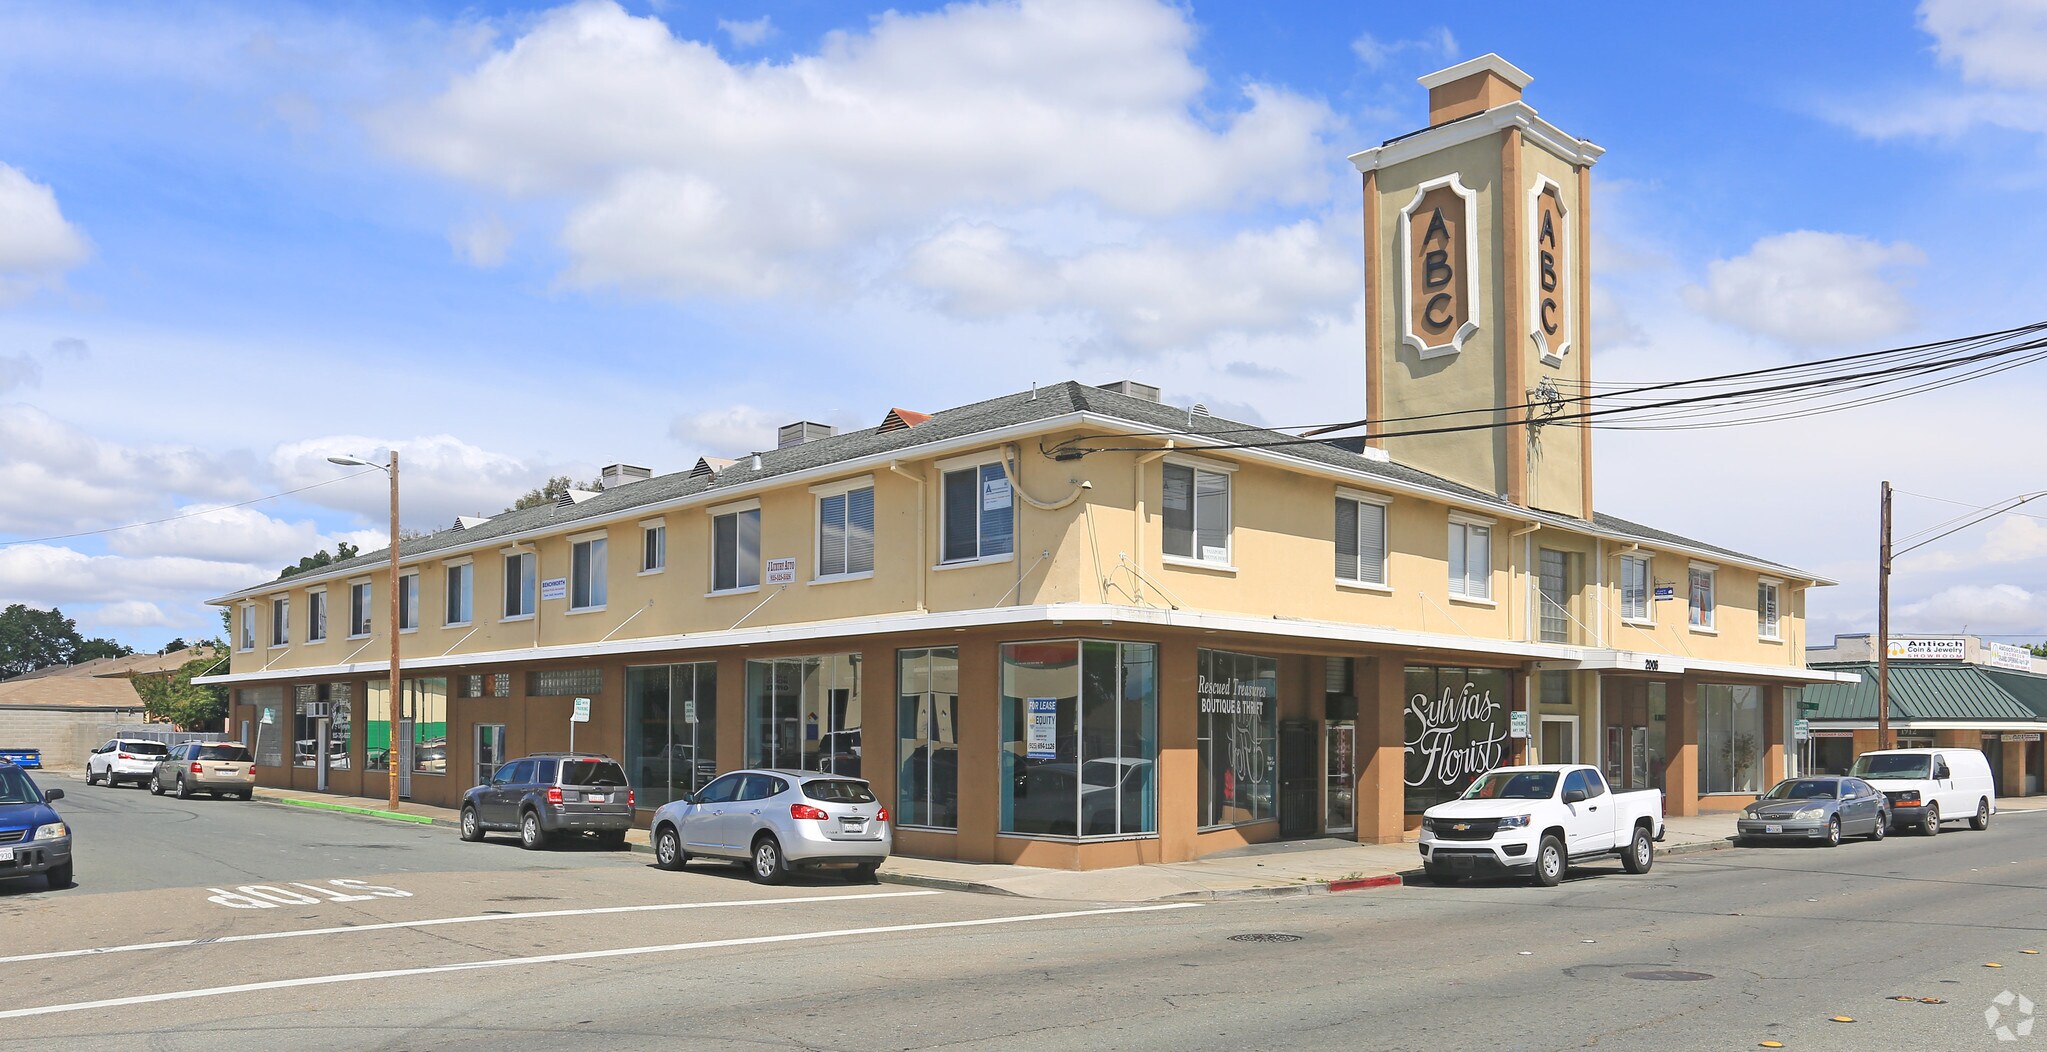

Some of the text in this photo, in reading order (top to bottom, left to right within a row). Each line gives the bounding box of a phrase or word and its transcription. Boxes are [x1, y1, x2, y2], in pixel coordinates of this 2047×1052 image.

[1423, 206, 1454, 329] ABC
[1539, 208, 1558, 336] ABC
[1645, 658, 1659, 671] 2006
[1198, 675, 1267, 698] Rescued Treasures
[1029, 701, 1056, 710] FOR LEASE
[1201, 698, 1263, 715] BOUTIQUE & THRIFT
[1404, 682, 1501, 746] Sylvias
[1035, 715, 1055, 725] EQUITY
[1404, 722, 1508, 787] Florist
[207, 878, 414, 909] STOP
